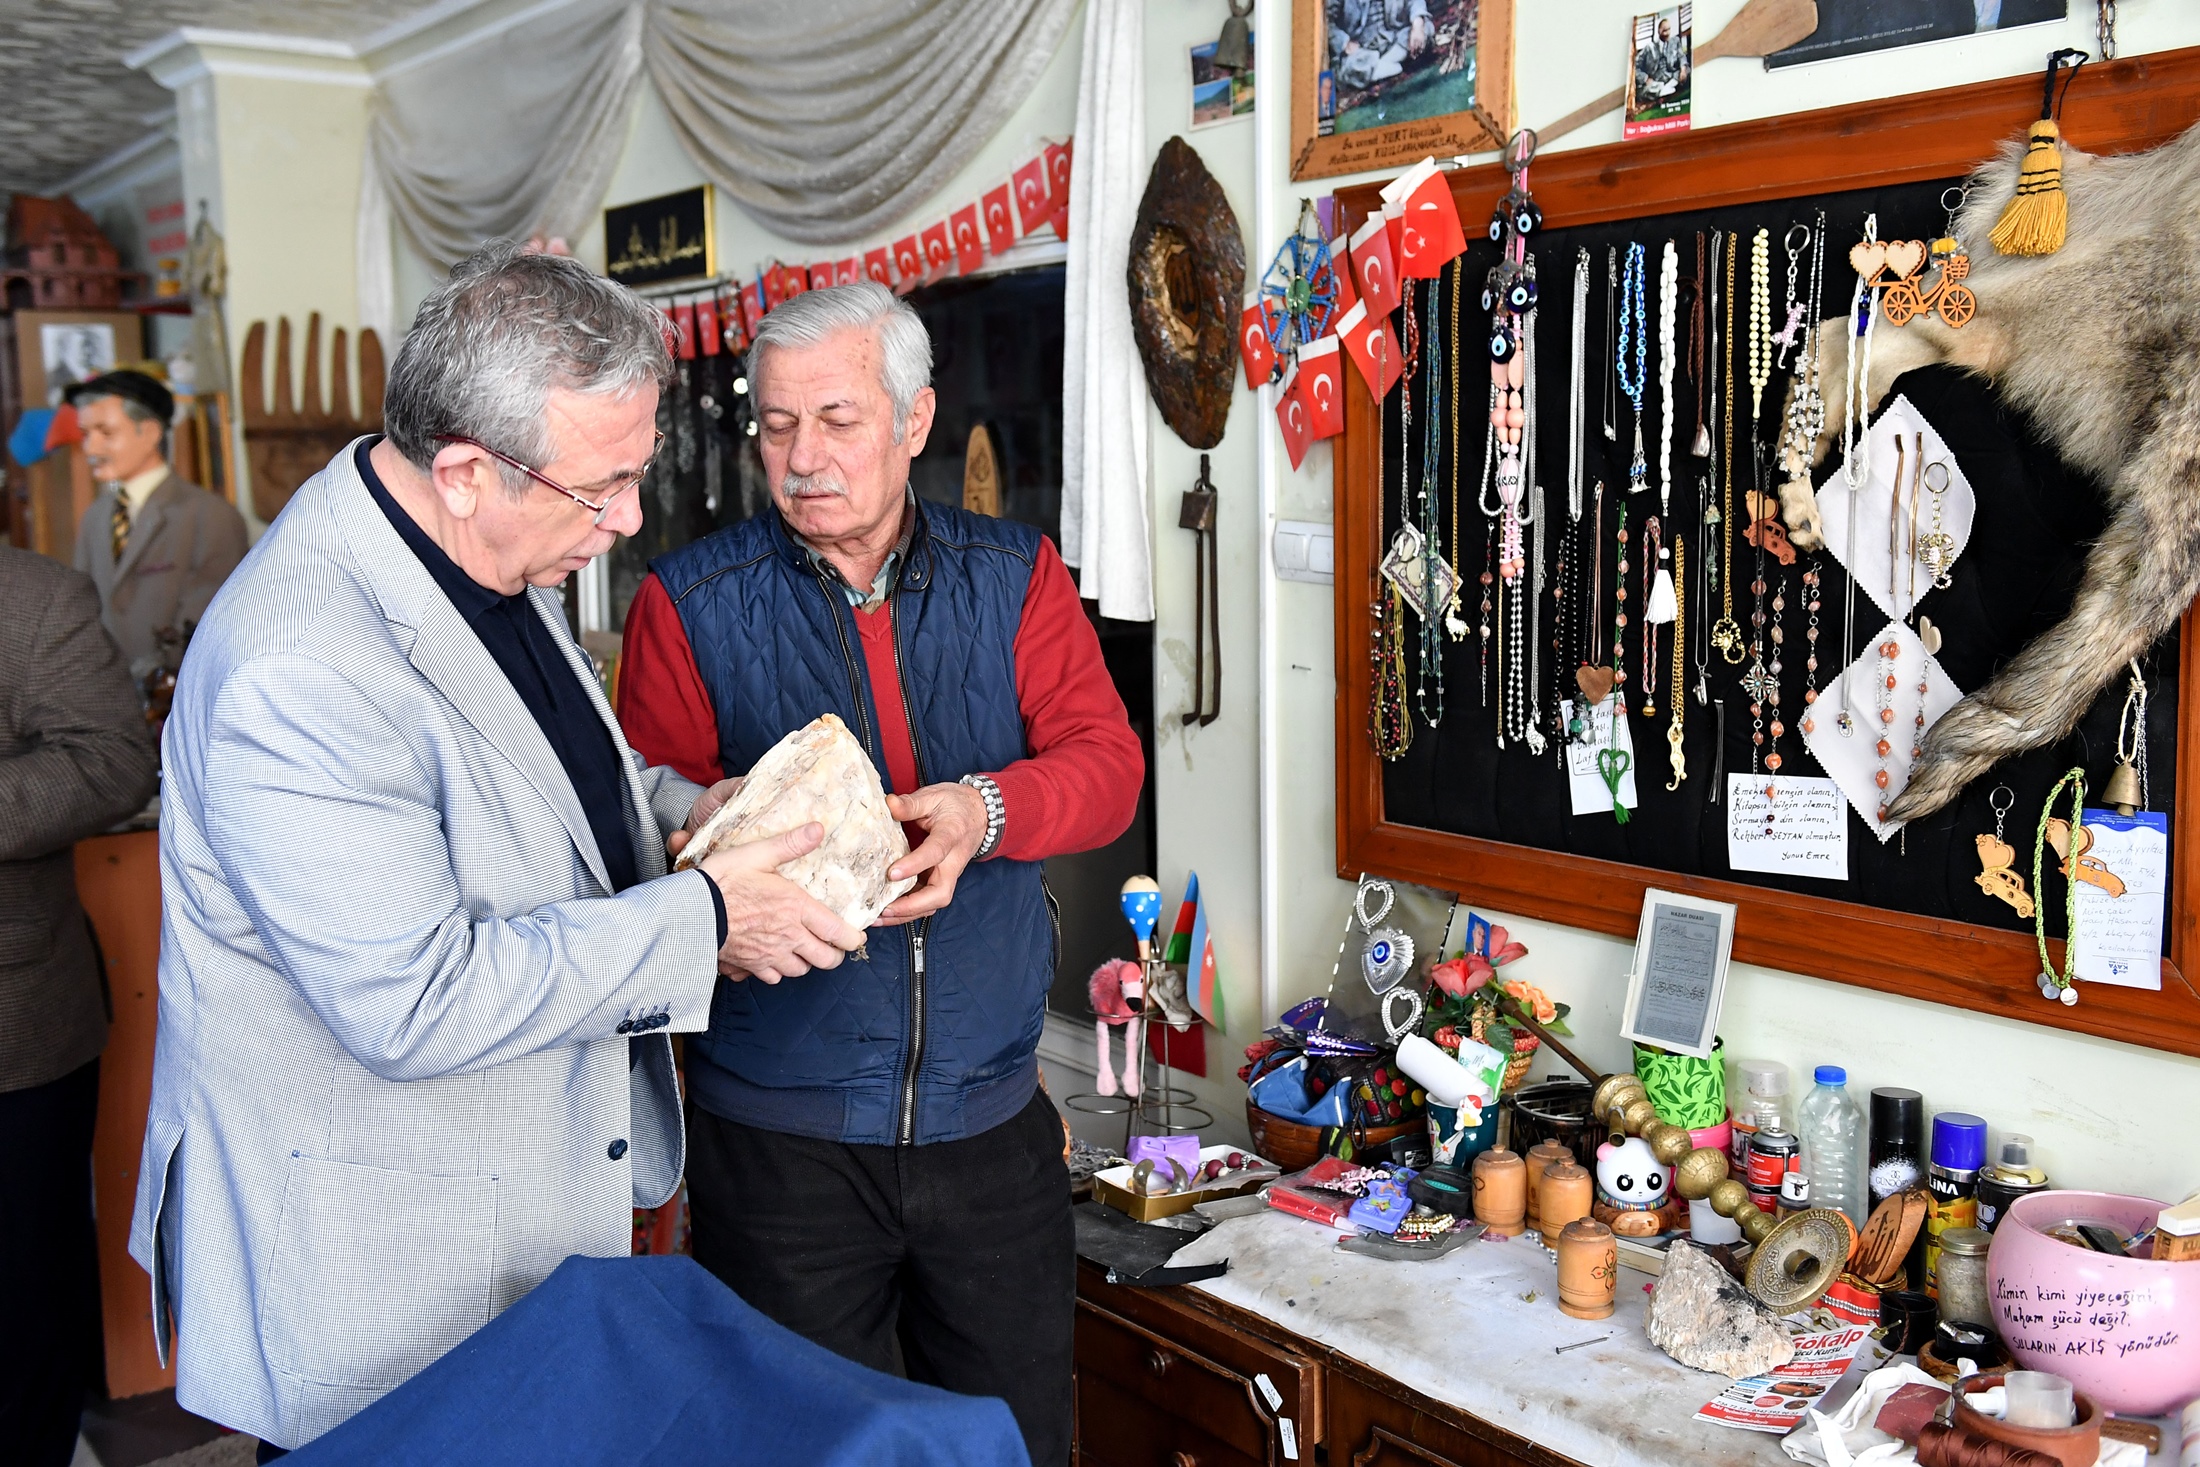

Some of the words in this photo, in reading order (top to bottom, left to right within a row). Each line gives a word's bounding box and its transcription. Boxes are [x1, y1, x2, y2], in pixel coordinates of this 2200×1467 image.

[1782, 851, 1804, 861] Yunus
[1806, 851, 1830, 861] Emre
[1996, 1277, 2028, 1301] Kimin
[2037, 1285, 2066, 1301] kimi
[2051, 1310, 2082, 1329] gücü
[1813, 1346, 1842, 1356] Kursu
[2012, 1336, 2057, 1355] SULARIN
